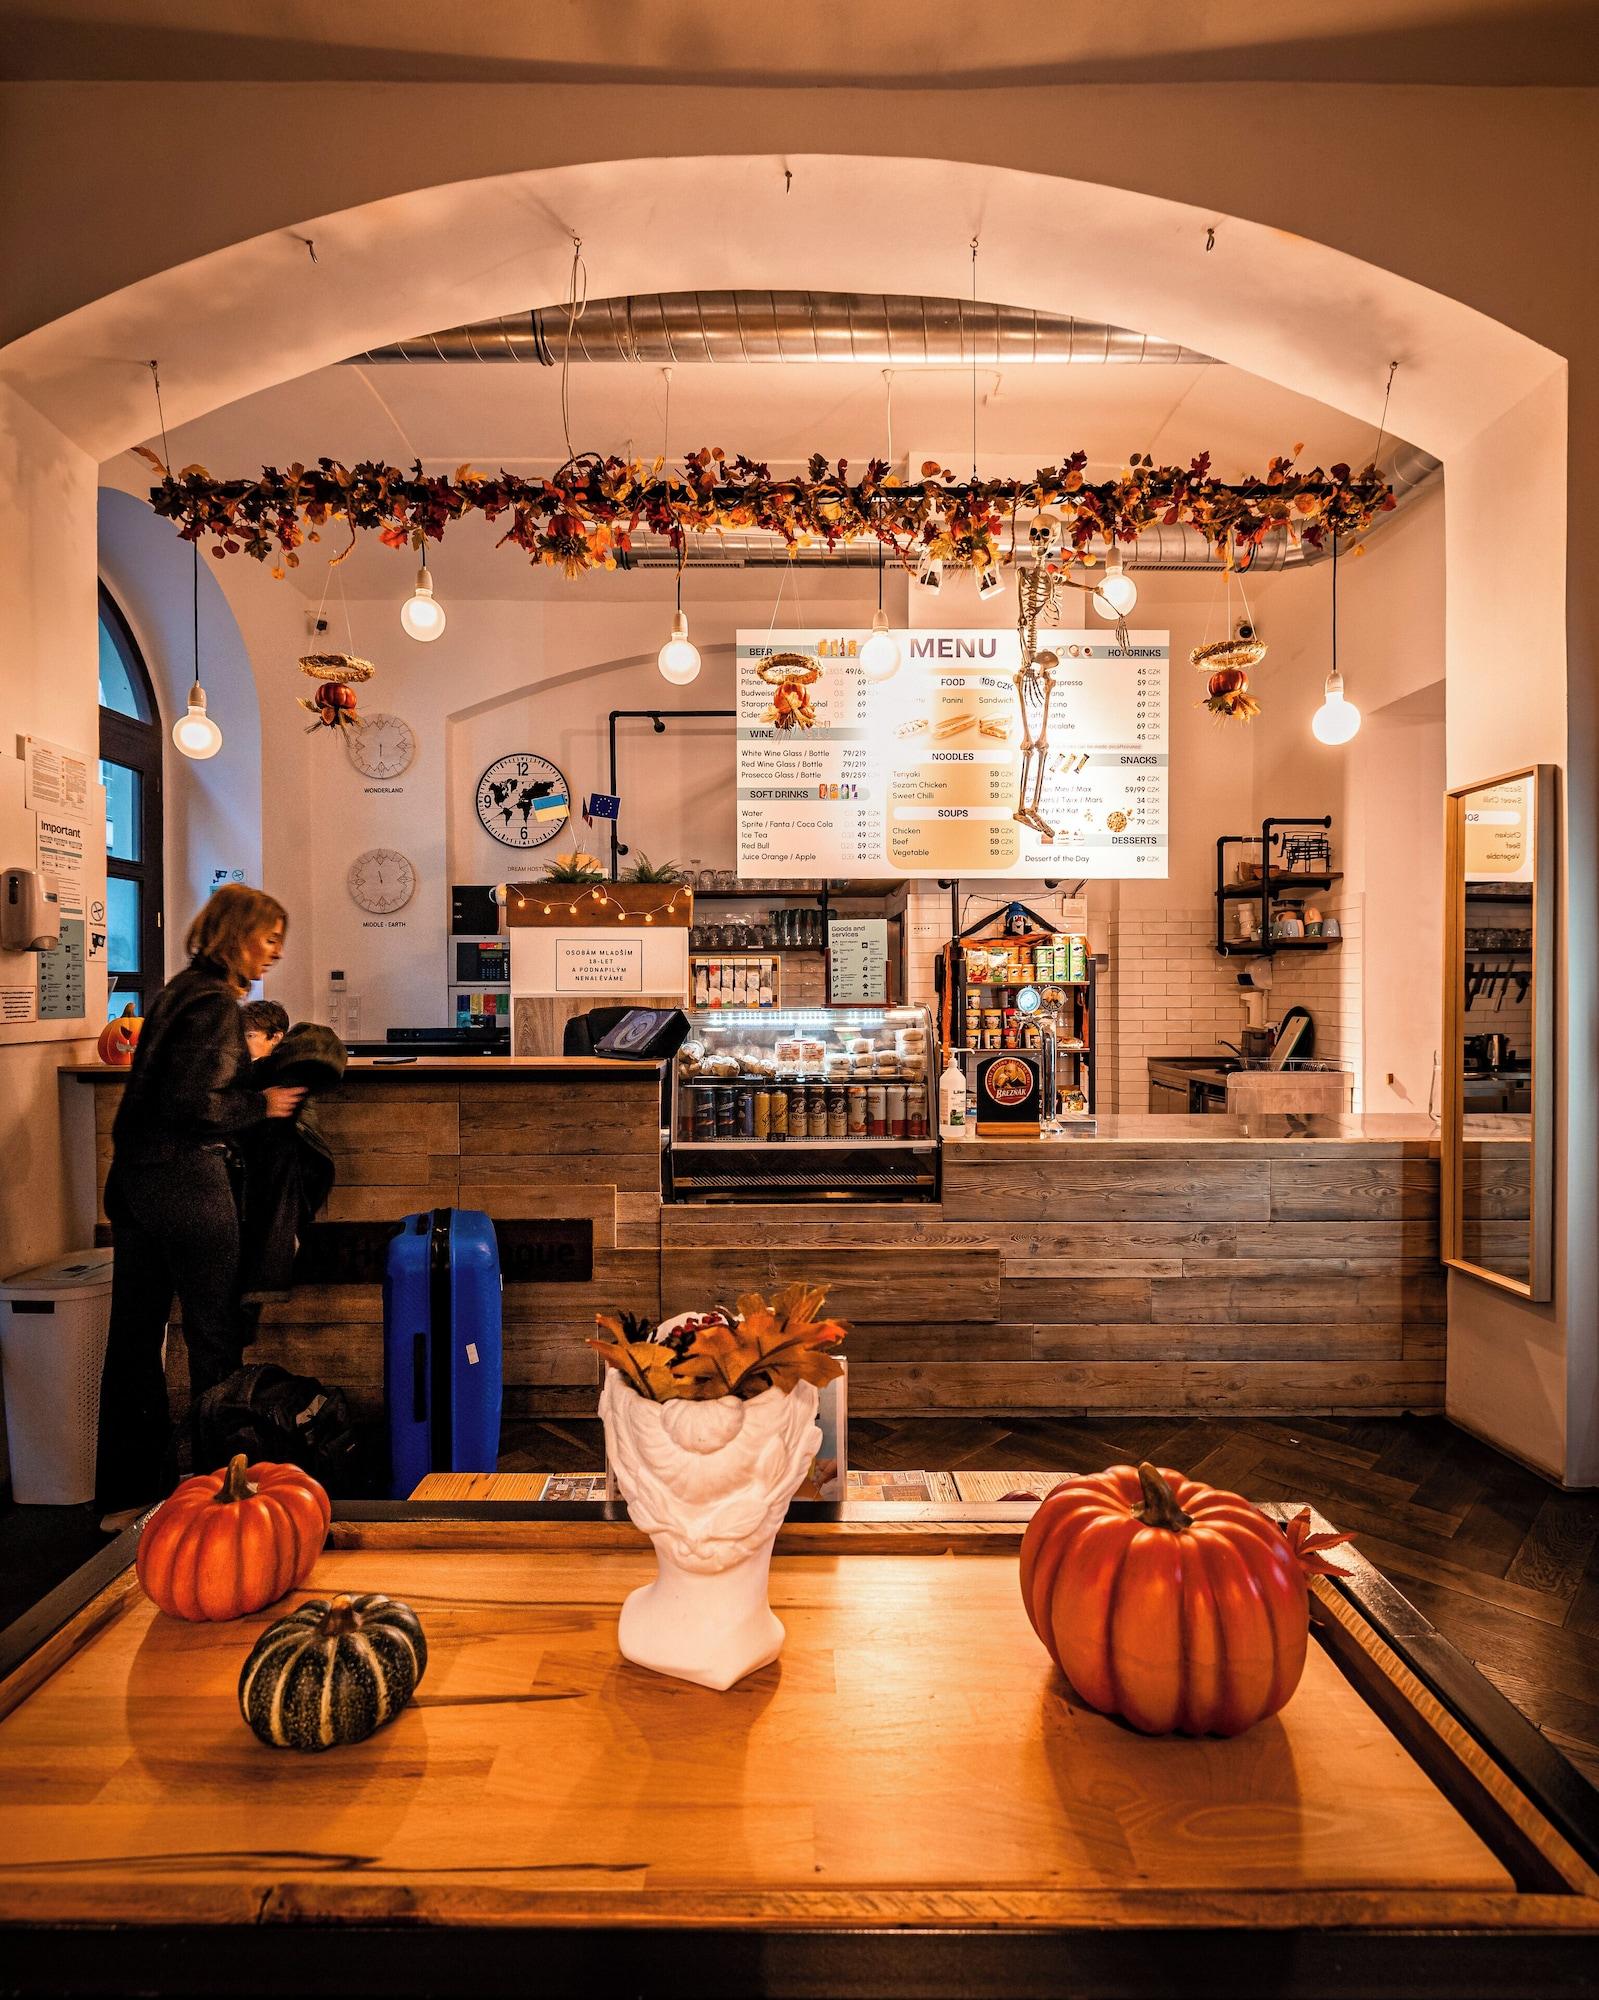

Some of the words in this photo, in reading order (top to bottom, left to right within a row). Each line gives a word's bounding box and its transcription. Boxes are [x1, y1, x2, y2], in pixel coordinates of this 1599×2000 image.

[749, 648, 773, 656] BEER
[910, 638, 997, 658] MENU
[1126, 649, 1162, 657] DRINKS
[940, 678, 966, 686] FOOD
[981, 677, 996, 687] 109
[996, 680, 1013, 691] CZK
[750, 730, 774, 738] WINE
[932, 753, 974, 761] NOODLES
[1120, 756, 1158, 764] SNACKS
[516, 762, 529, 776] 12
[750, 790, 773, 798] SOFT
[775, 790, 809, 798] DRINKS
[484, 794, 492, 808] 9
[938, 809, 969, 818] SOUPS
[41, 820, 80, 838] Important
[520, 826, 528, 840] 6
[1112, 836, 1157, 844] DESSERTS
[893, 849, 929, 857] Vegetable
